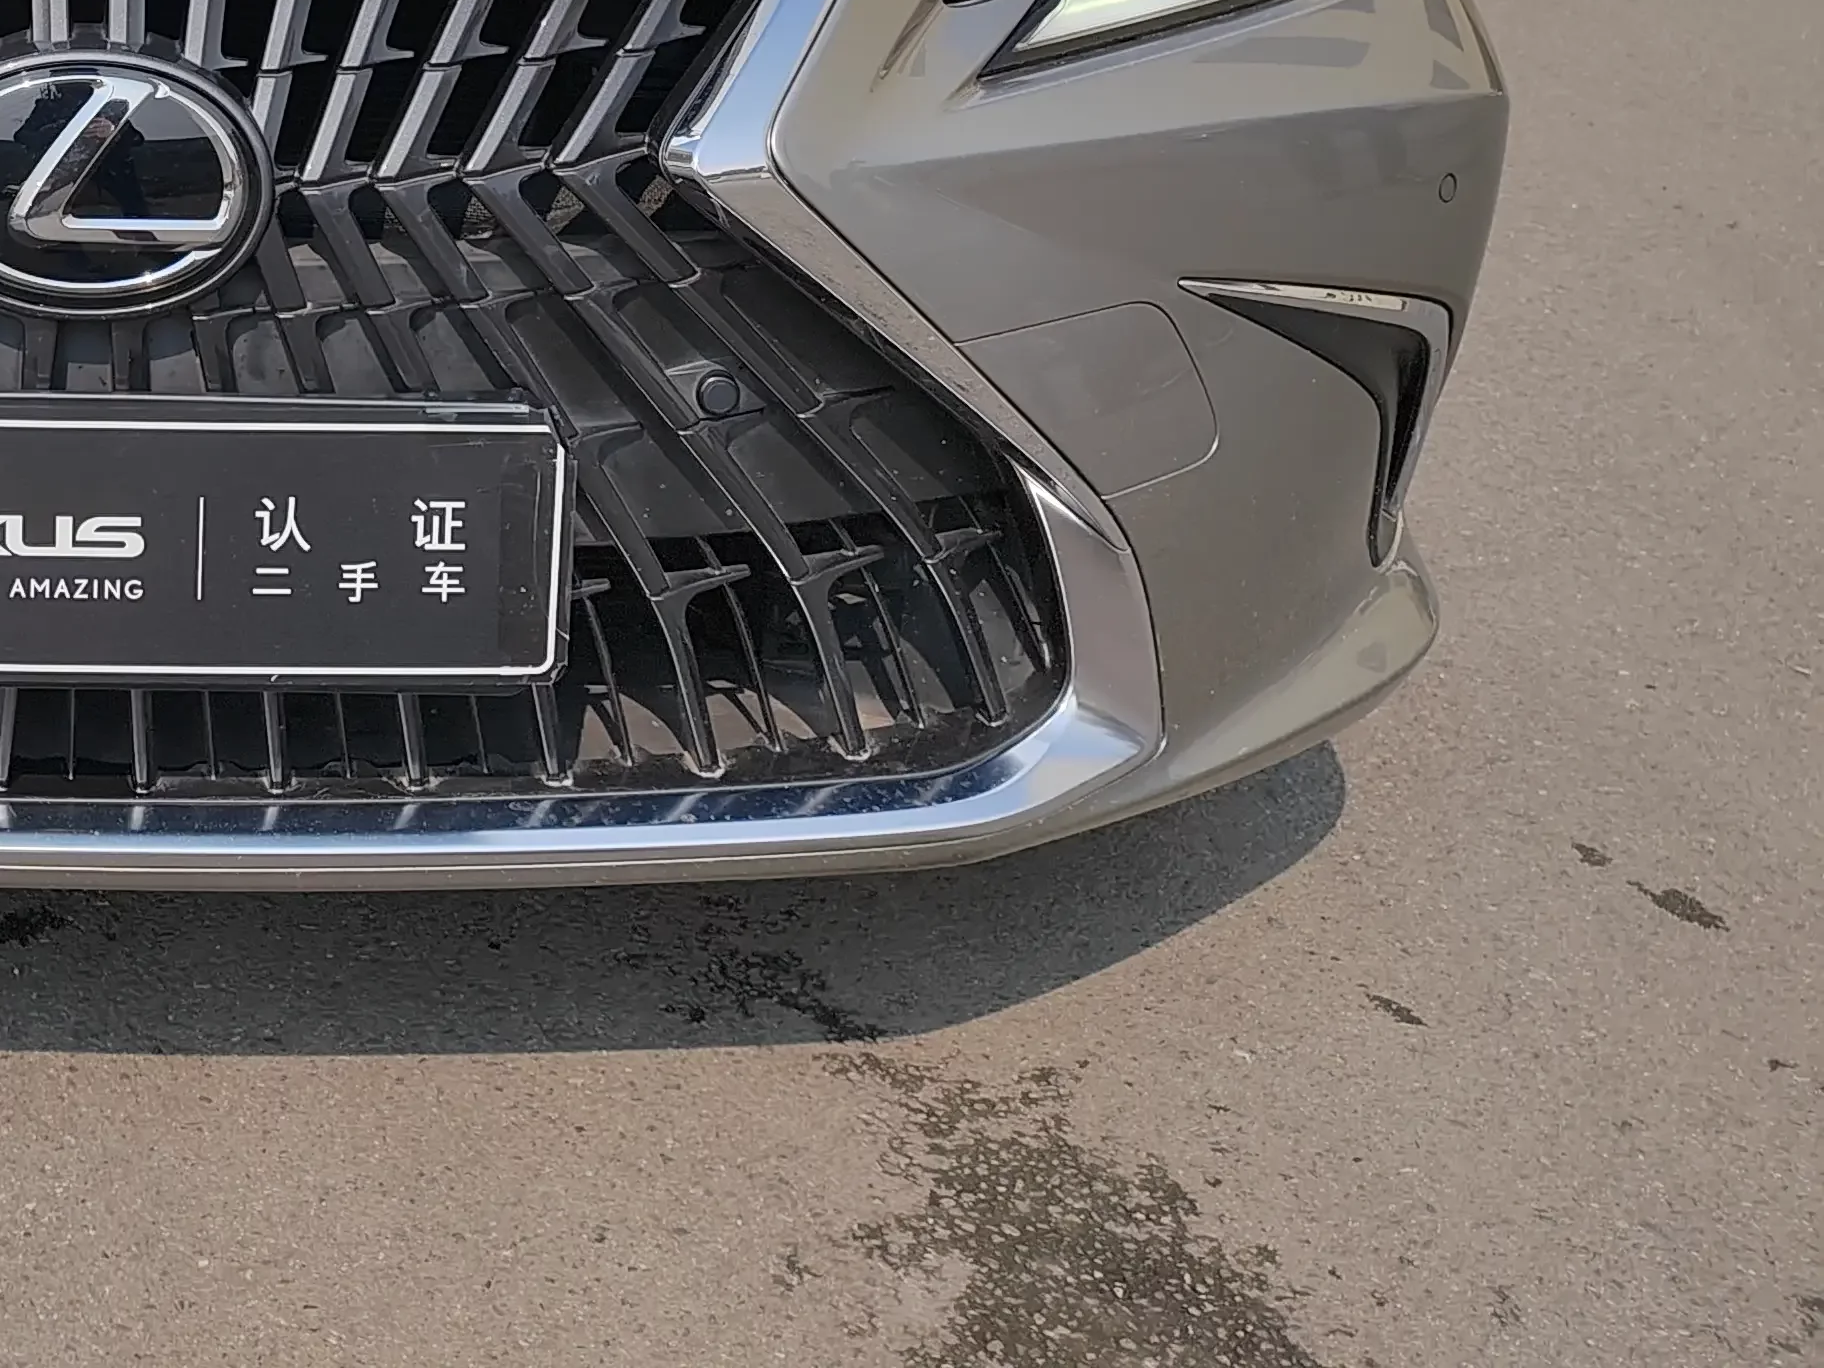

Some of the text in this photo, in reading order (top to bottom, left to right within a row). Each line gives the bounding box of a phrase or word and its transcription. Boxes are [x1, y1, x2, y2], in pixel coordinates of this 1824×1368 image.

[254, 495, 466, 552] 认证
[8, 577, 145, 601] AMAZING
[251, 561, 466, 603] 二手车
